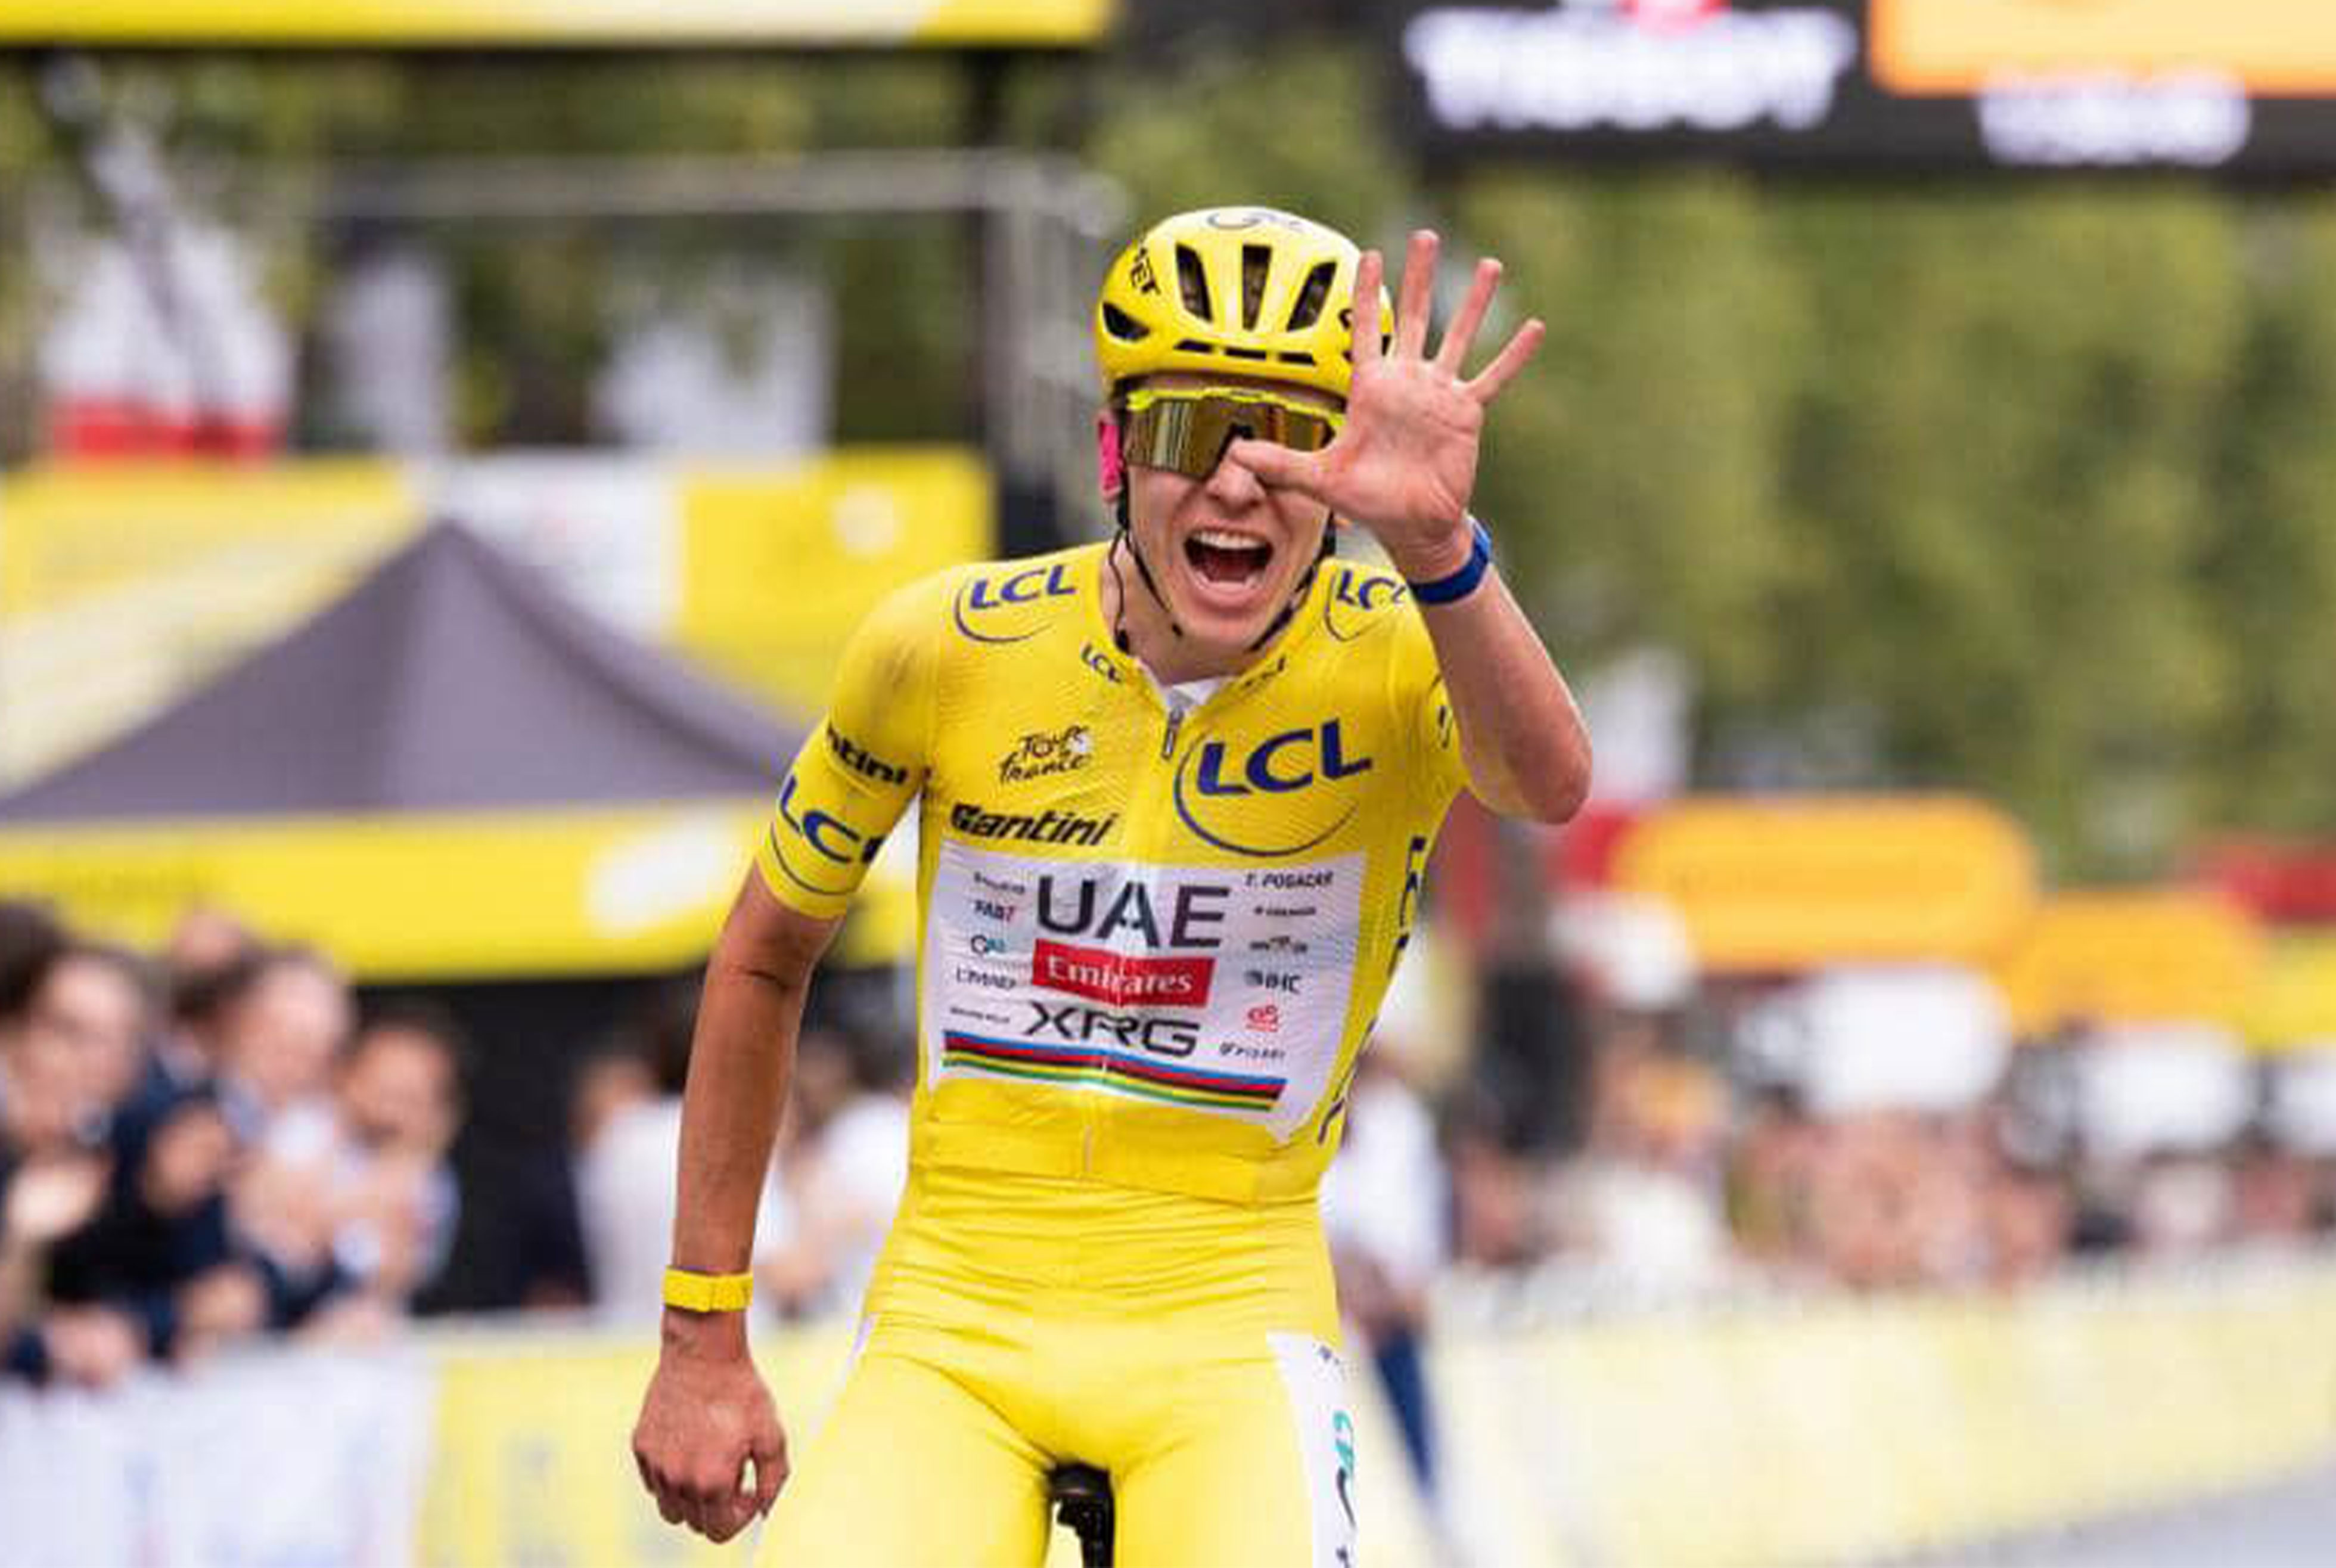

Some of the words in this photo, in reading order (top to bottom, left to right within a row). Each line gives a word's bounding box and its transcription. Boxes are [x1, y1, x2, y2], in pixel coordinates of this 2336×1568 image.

[970, 564, 1077, 610] LCL
[1080, 644, 1122, 683] LCL
[1197, 718, 1373, 793] LCL
[1037, 875, 1232, 948] UAE
[1047, 954, 1194, 994] Emirates
[1024, 1000, 1200, 1058] XRG
